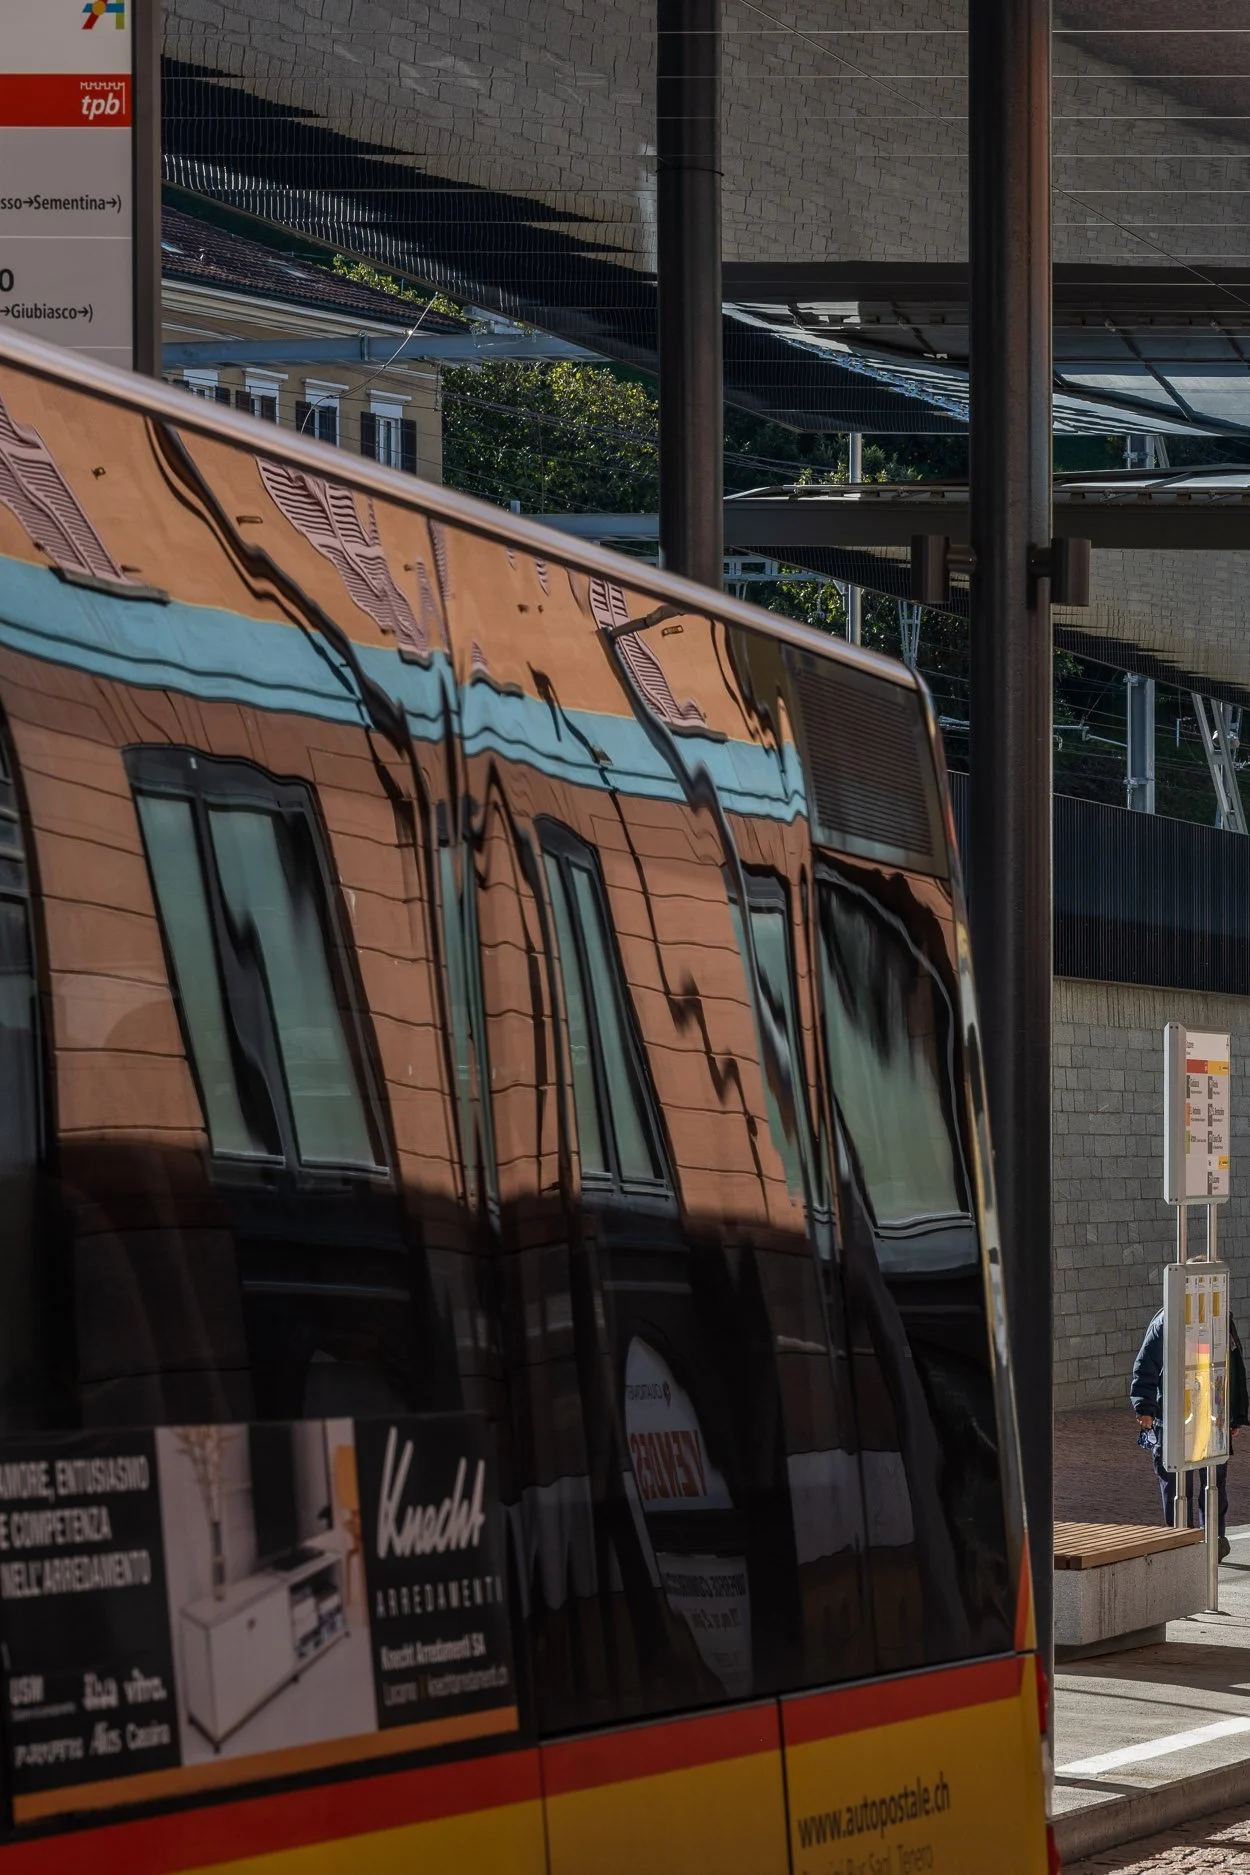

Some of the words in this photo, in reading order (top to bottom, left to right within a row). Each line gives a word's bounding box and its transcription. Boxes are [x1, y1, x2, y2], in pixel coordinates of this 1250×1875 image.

[81, 92, 120, 120] tpb
[0, 1461, 55, 1503] AMORE,
[55, 1454, 150, 1497] ENTUSIASMO
[376, 1425, 486, 1560] Knecht
[0, 1513, 10, 1551] E
[10, 1505, 113, 1549] COMPETENZA
[1, 1549, 152, 1600] NELL'ARREDAMENTO
[376, 1575, 503, 1619] ARREDAMENTI
[9, 1674, 44, 1707] USM
[798, 1769, 951, 1849] www.autopostale.ch
